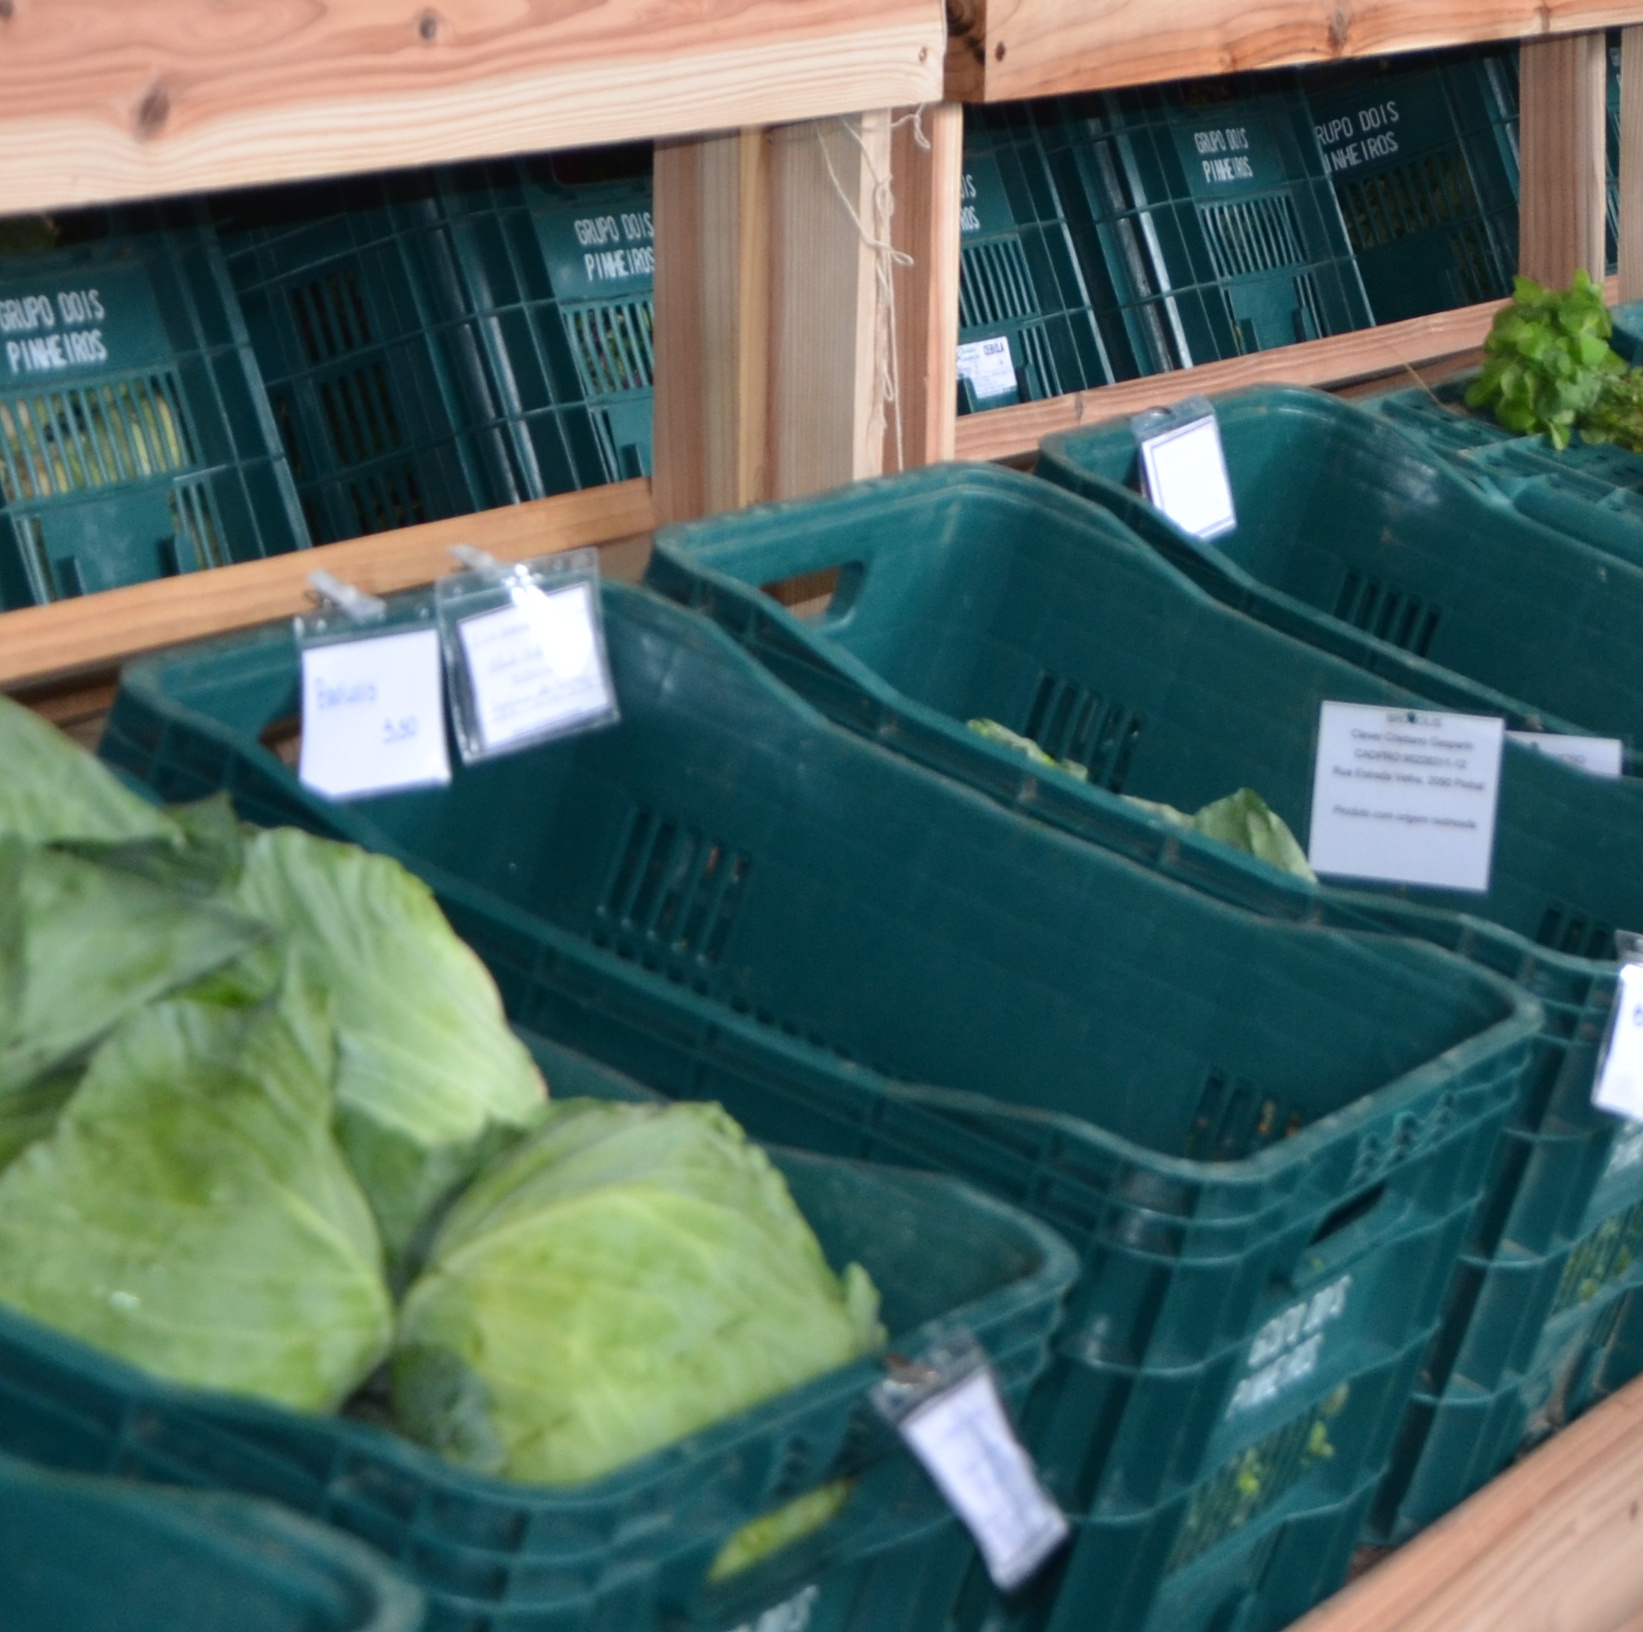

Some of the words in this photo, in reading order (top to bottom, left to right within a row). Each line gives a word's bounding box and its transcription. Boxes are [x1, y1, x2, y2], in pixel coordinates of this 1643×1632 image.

[1194, 129, 1227, 154] GRUPO
[1225, 126, 1249, 151] DOIS
[1314, 116, 1354, 145] RUPO
[1358, 100, 1400, 132] DOIS
[1202, 155, 1254, 184] PINHEIROS
[574, 215, 620, 245] GRUPO
[621, 211, 654, 240] DOIS
[584, 246, 655, 281] PINHEIROS
[57, 288, 106, 323] DOIS
[6, 328, 108, 375] PINHEIROS
